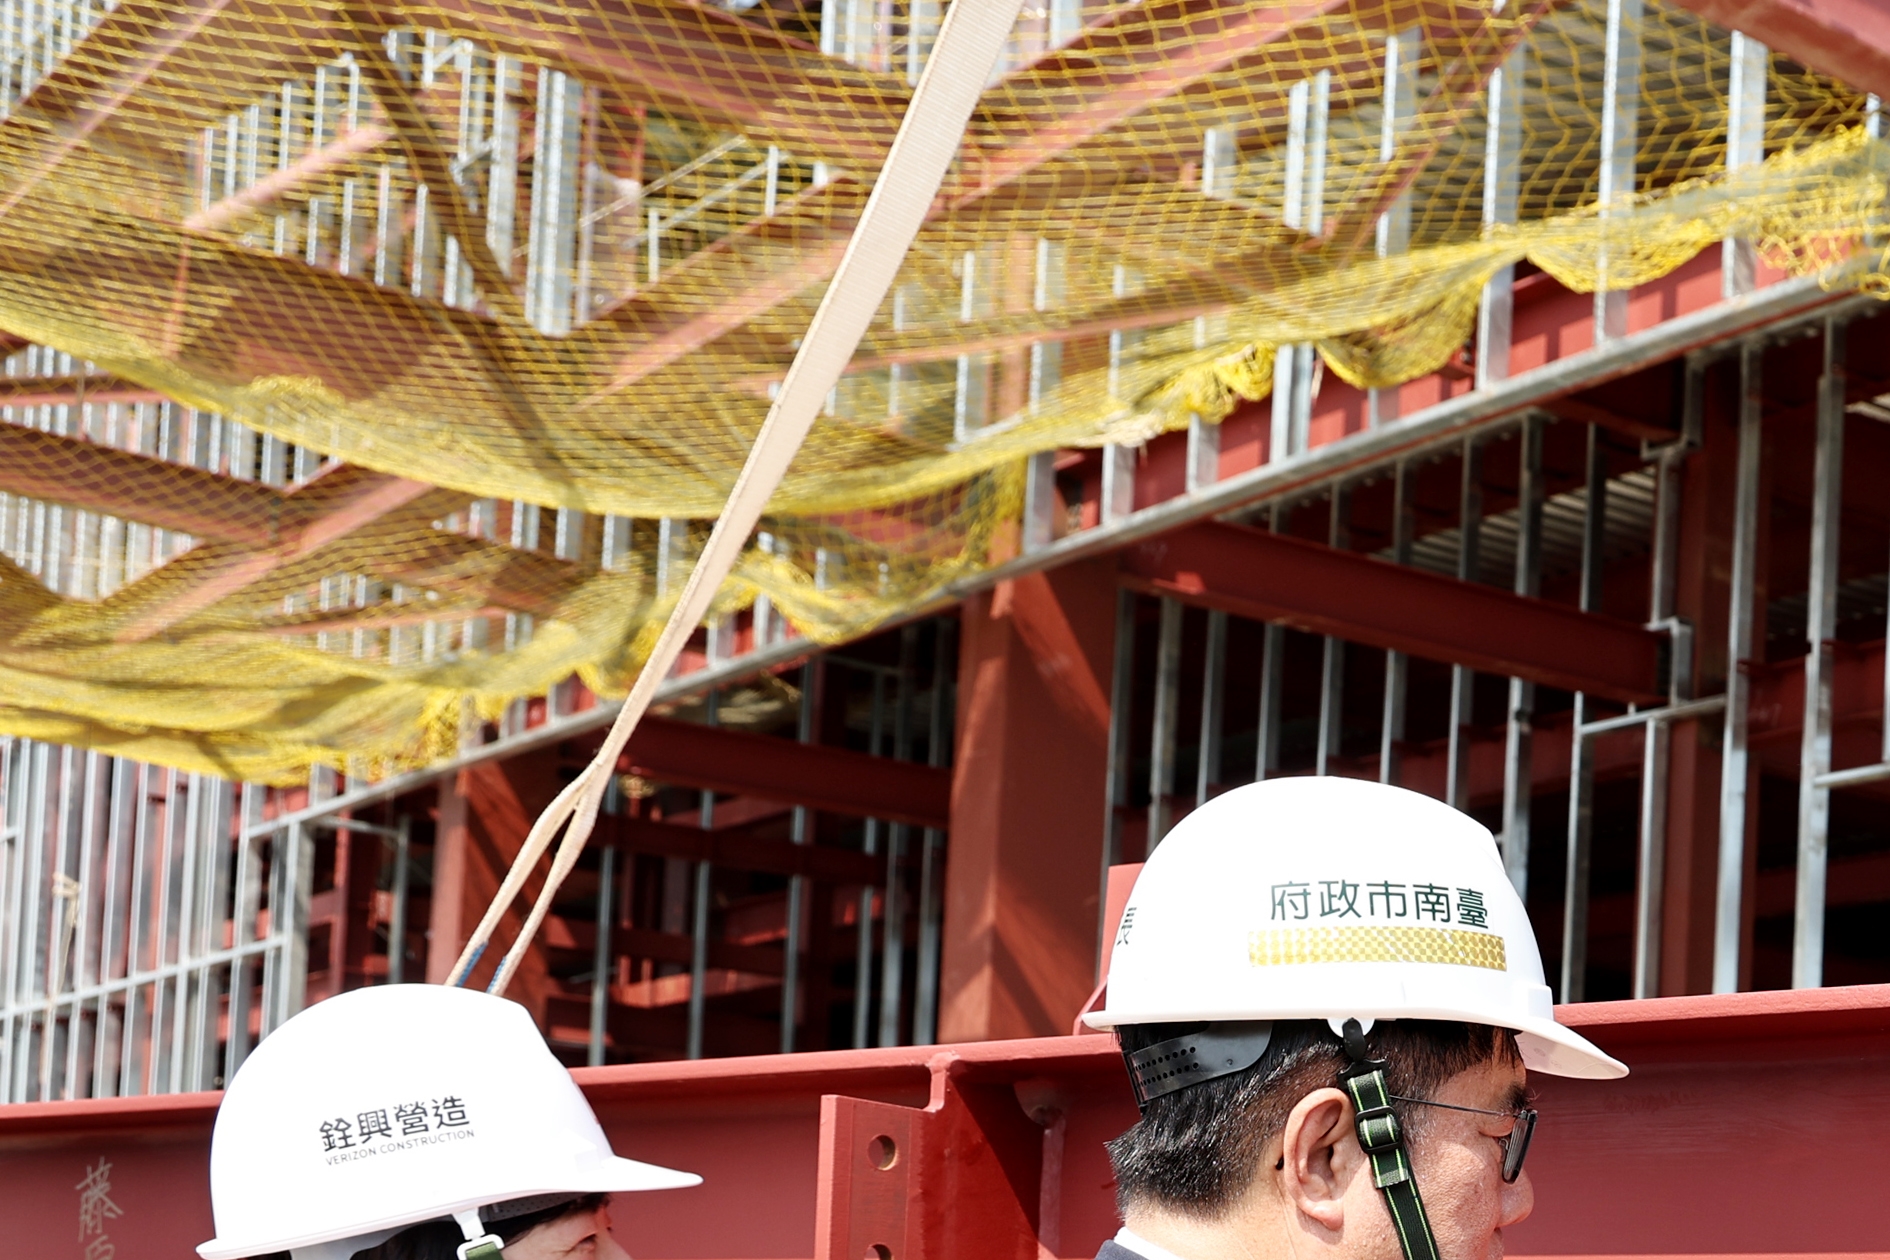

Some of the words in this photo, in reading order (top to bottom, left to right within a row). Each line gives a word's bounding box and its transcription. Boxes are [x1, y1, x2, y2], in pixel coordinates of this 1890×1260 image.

[319, 1095, 470, 1152] 銓興營造
[325, 1146, 377, 1167] VERIZON
[379, 1128, 475, 1156] CONSTRUCTION
